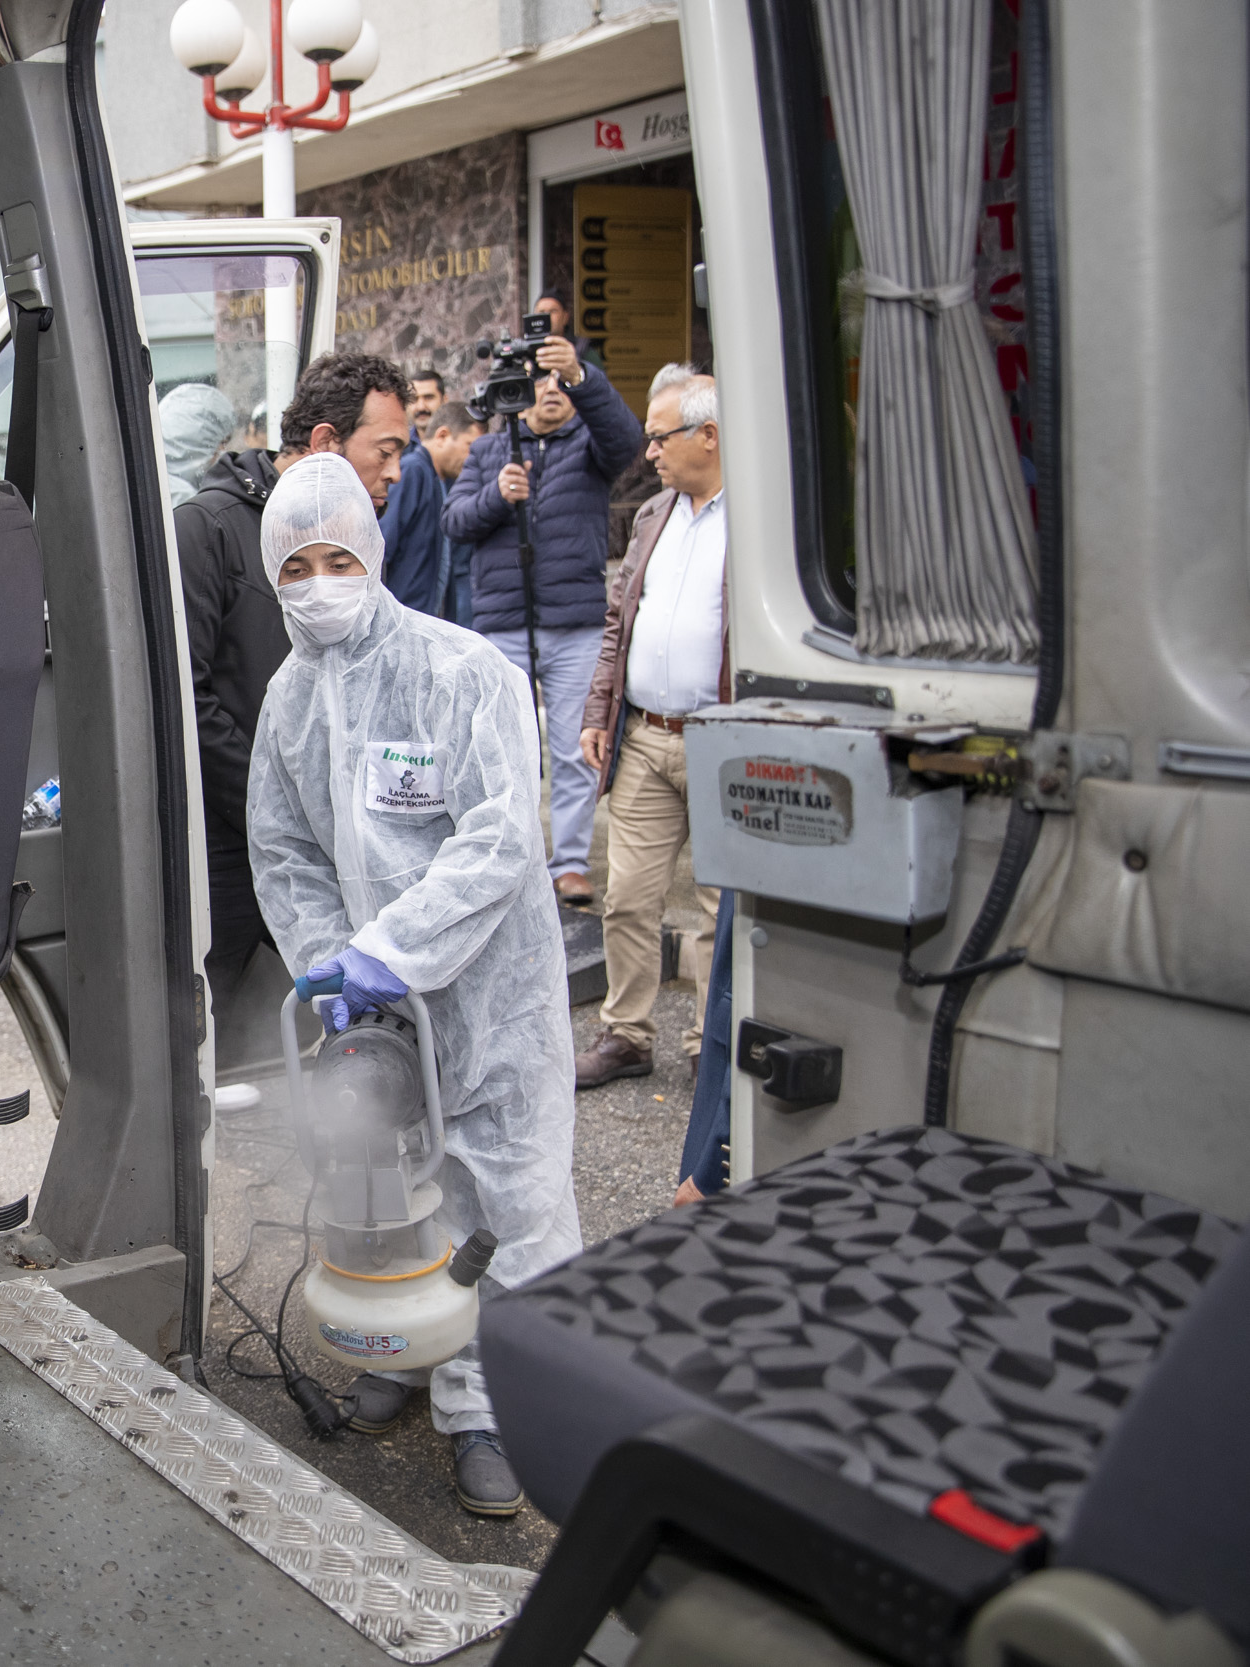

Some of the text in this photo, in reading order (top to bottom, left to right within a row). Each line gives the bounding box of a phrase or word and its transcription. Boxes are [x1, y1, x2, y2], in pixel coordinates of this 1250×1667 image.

[382, 747, 434, 767] Insecto
[388, 786, 431, 799] İLAÇLAMA
[727, 783, 801, 807] OTOMATİK
[375, 795, 445, 808] DEZENFEKSİYON
